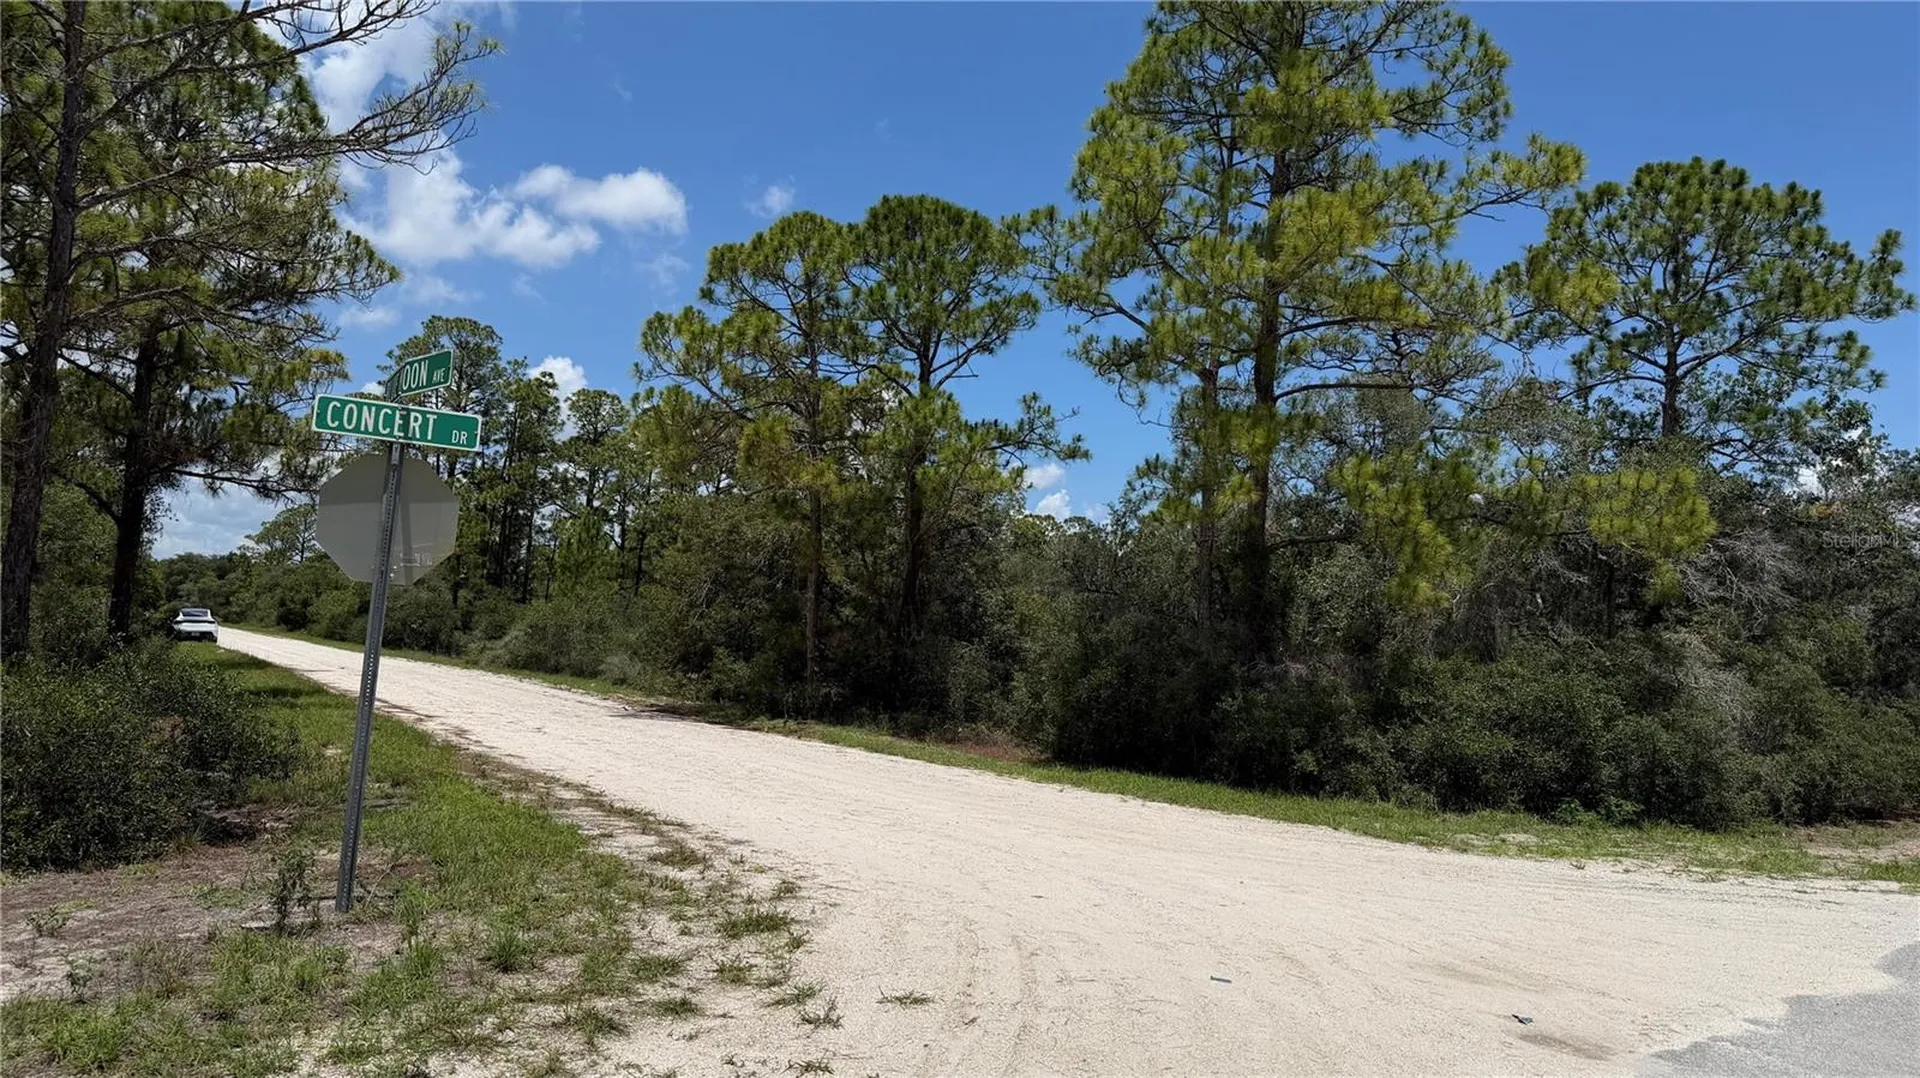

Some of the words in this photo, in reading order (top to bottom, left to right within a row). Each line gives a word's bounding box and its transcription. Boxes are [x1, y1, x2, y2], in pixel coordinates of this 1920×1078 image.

[432, 368, 445, 383] AVE
[326, 401, 437, 440] CONCERT
[452, 430, 468, 445] DR
